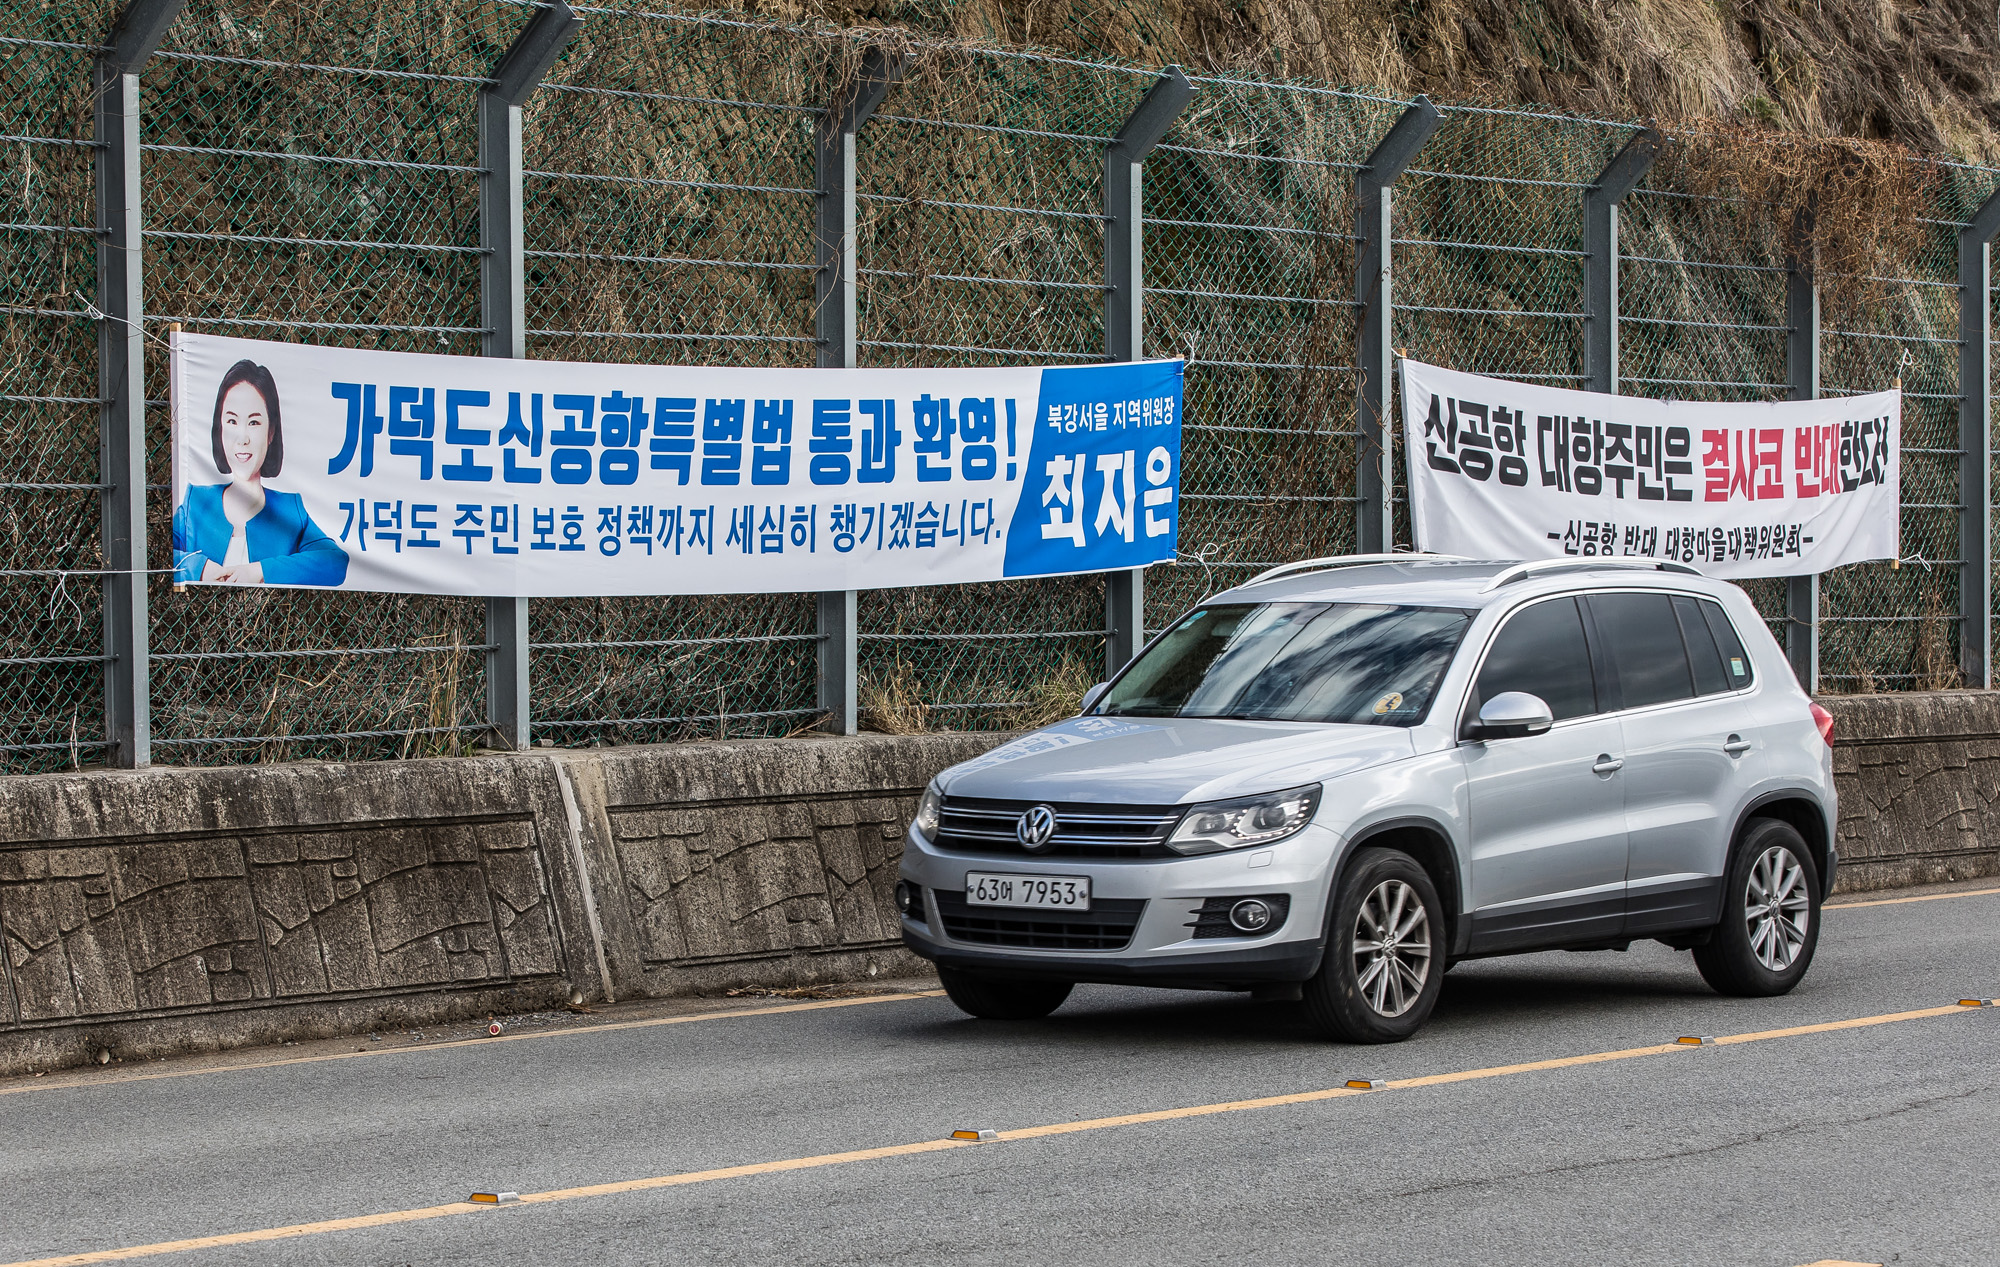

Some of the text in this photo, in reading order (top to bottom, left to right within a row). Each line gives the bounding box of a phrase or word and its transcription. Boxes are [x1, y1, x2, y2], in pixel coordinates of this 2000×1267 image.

[328, 382, 1016, 486] 가덕도신공항특별법 통과 환영!
[1047, 395, 1174, 433] 북강서을 지역위원장
[1424, 393, 1528, 487] 신공항
[1537, 414, 1693, 502] 대항주민은
[1702, 428, 1784, 502] 결사코
[1041, 446, 1174, 548] 최지은
[338, 498, 1001, 557] 가덕도 주민 보호 정책까지 세심히 챙기겠습니다.
[1624, 525, 1658, 557] 반대
[976, 878, 1076, 905] 63어 7953
